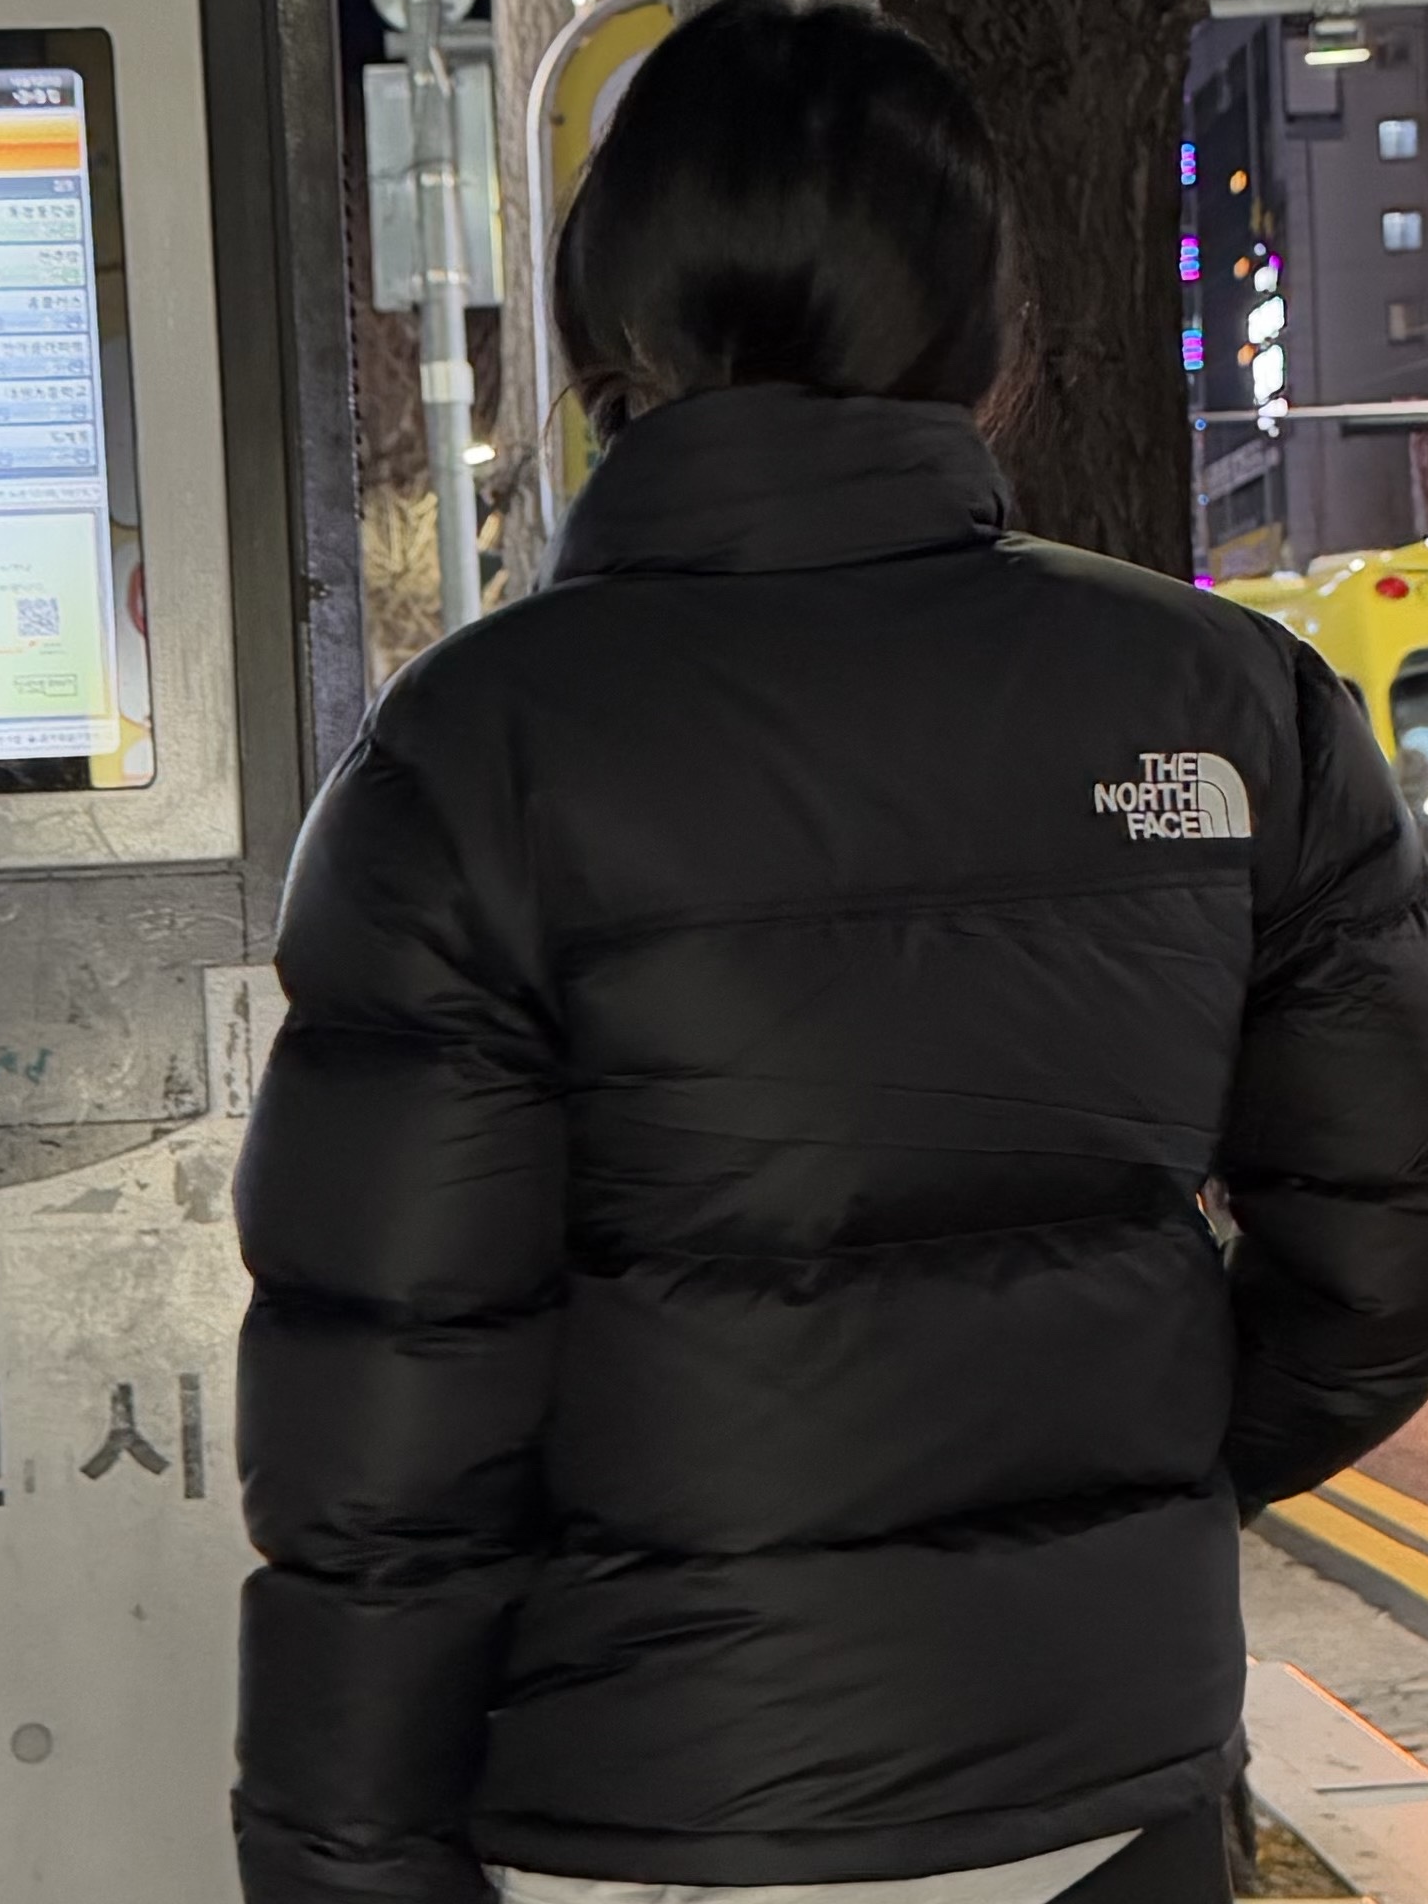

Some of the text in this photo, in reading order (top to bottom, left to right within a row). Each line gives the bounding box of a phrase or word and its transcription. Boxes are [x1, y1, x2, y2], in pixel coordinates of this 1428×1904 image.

[1139, 752, 1199, 783] THE
[1093, 781, 1198, 814] NORTH
[1126, 811, 1203, 841] FACE
